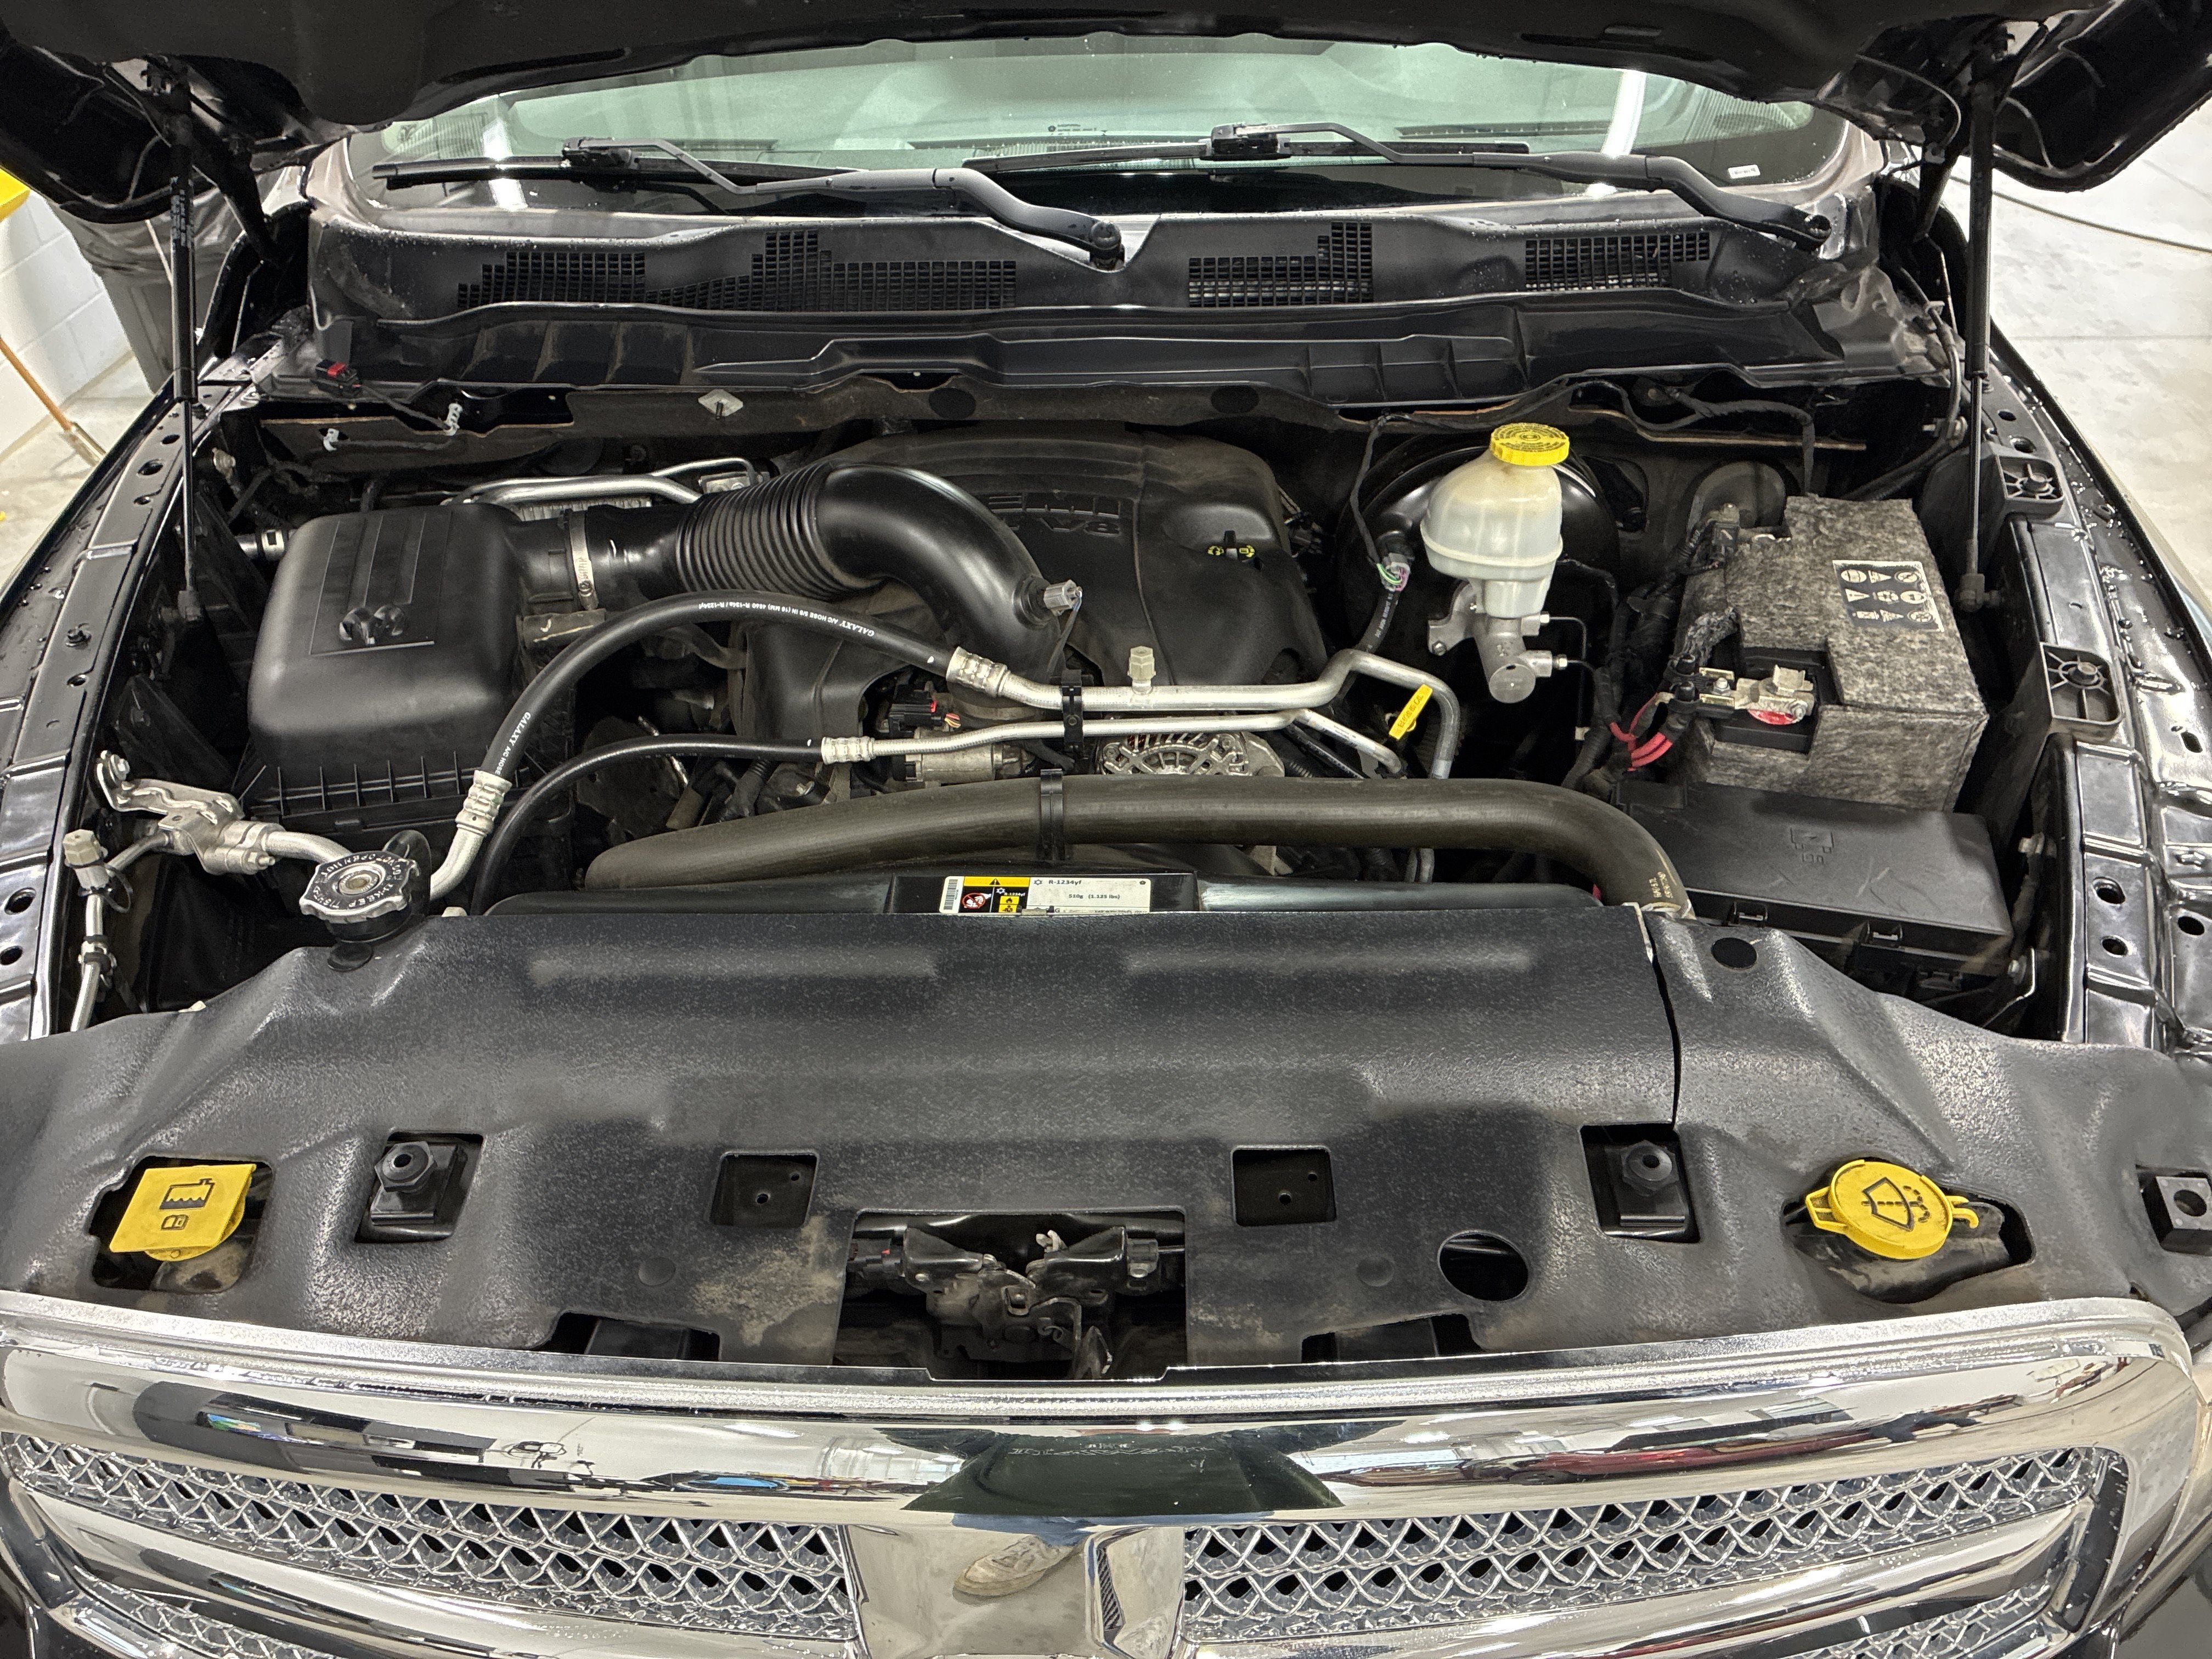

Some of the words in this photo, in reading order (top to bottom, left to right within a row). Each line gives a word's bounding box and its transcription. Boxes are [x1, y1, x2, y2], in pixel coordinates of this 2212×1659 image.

[810, 612, 827, 621] HOSE
[839, 620, 874, 637] GALAXY
[509, 712, 531, 746] GALAXY
[495, 757, 506, 775] HOSE
